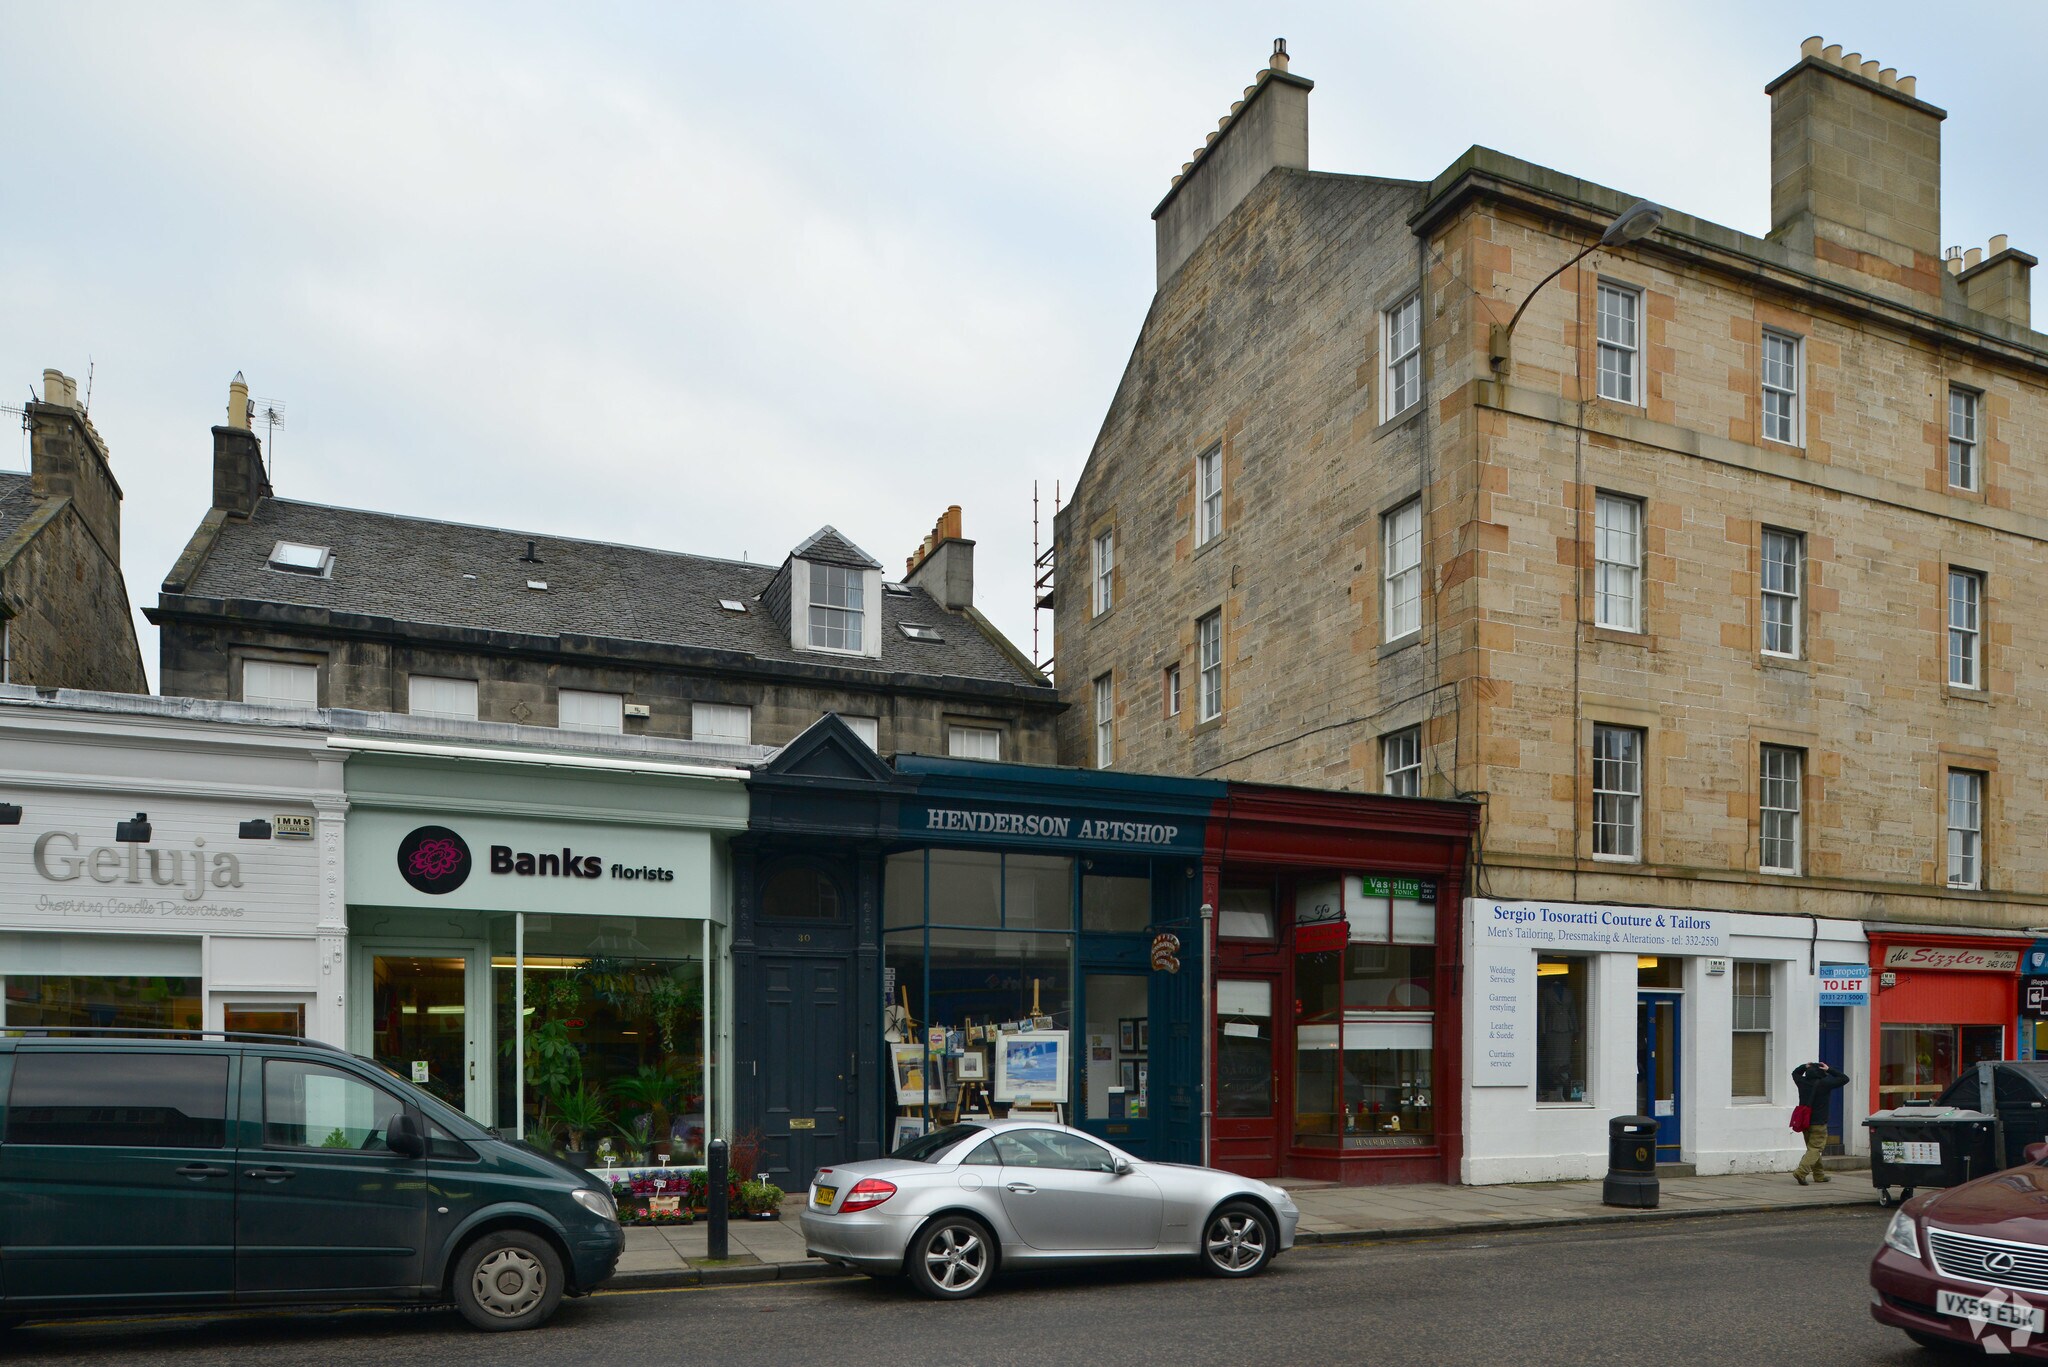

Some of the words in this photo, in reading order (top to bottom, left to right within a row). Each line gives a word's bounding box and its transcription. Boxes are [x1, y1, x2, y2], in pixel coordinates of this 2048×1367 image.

[277, 817, 310, 826] IMMS
[926, 808, 1071, 838] HENDERSON
[1077, 819, 1178, 845] ARTSHOP
[33, 830, 243, 901] Geluja
[490, 844, 602, 879] Banks
[610, 863, 675, 882] florists
[1369, 878, 1419, 891] Vaseline
[35, 894, 103, 918] Inspiring
[107, 898, 155, 916] Candle
[156, 900, 245, 917] Decorations
[1493, 905, 1536, 925] Sergio
[1539, 908, 1598, 925] Tosoratti
[1601, 911, 1652, 928] Couture
[1655, 914, 1666, 928] &
[1669, 915, 1711, 930] Tailors
[1487, 926, 1513, 938] Men's
[1514, 927, 1556, 942] Tailoring,
[1558, 929, 1611, 944] Dressmaking
[1612, 932, 1620, 943] &
[1622, 932, 1665, 945] Alterations
[1671, 935, 1683, 946] tel:
[1685, 936, 1719, 947] 332-2550
[1890, 948, 1908, 963] the
[1910, 948, 1984, 967] Sizzler
[1489, 965, 1516, 977] Wedding
[1820, 966, 1867, 978] benproperty
[1489, 974, 1515, 984] Services
[1823, 980, 1839, 990] TO
[1841, 980, 1862, 990] LET
[1489, 993, 1517, 1003] Garment
[1489, 1003, 1516, 1013] restyling
[1490, 1022, 1514, 1031] Leather
[1489, 1031, 1495, 1039] &
[1496, 1030, 1514, 1039] Suede
[1488, 1050, 1515, 1059] Curtains
[1490, 1059, 1512, 1068] service
